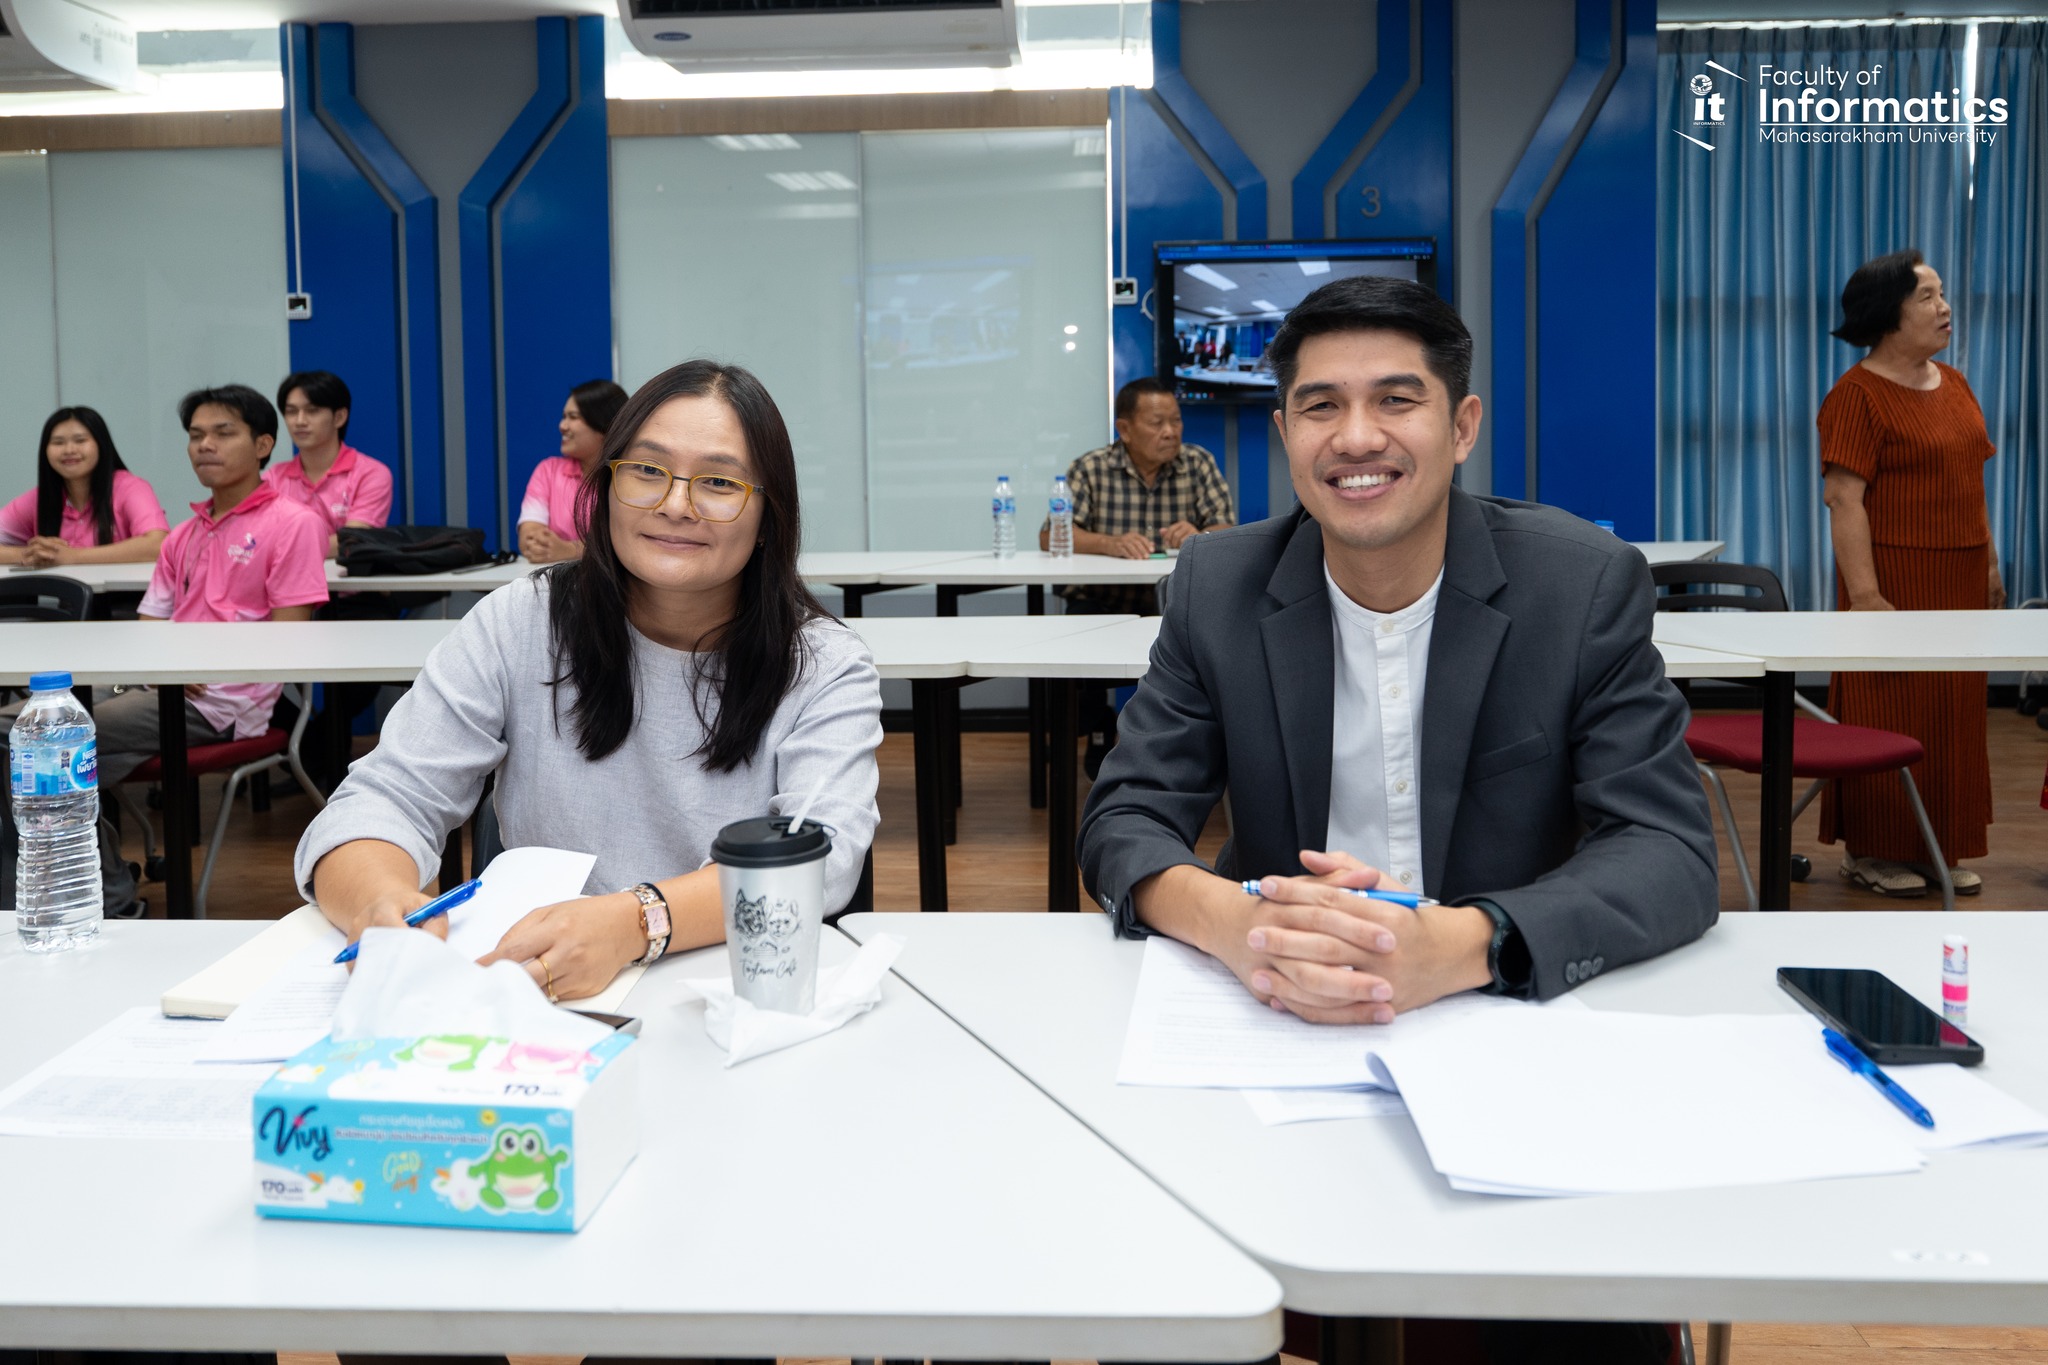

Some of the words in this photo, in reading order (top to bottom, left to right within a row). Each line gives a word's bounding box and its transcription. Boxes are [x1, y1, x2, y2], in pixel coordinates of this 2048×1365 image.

[1360, 185, 1381, 218] 3
[503, 1083, 540, 1097] 170
[259, 1104, 331, 1162] Vivy
[262, 1180, 285, 1194] 170
